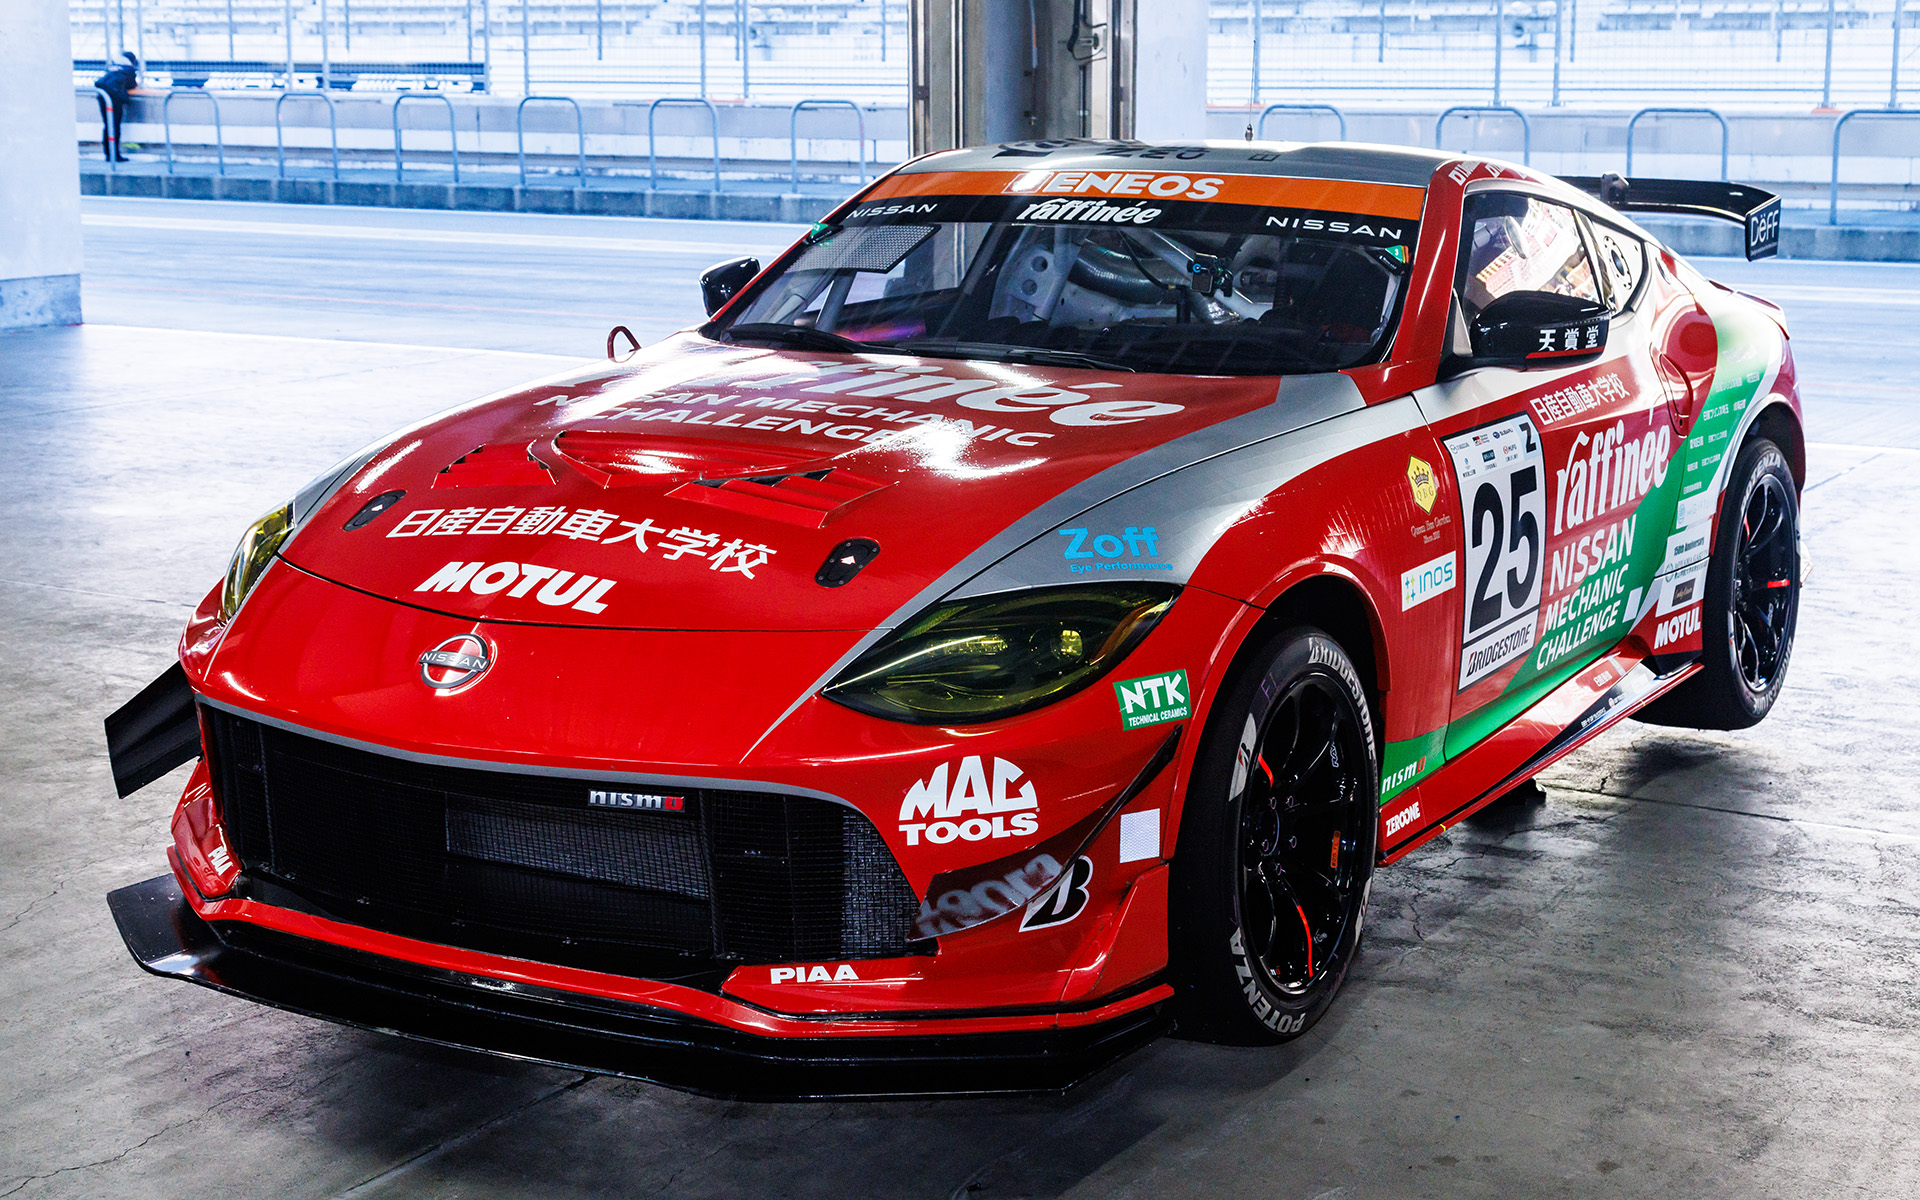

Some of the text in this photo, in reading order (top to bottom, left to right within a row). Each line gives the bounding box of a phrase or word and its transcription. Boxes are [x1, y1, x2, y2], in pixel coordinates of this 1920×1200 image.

[1042, 172, 1224, 199] ENEOS
[846, 203, 937, 219] NISSAN
[1015, 197, 1162, 224] raffinée
[1265, 215, 1402, 240] NISSAN
[533, 391, 741, 406] NSAN
[1529, 372, 1631, 425] 日産自動車大学校
[386, 506, 777, 579] 日産自動車大学校
[1058, 526, 1160, 559] Zoff
[1469, 464, 1540, 635] 25
[1549, 513, 1637, 597] NISSAN
[1070, 561, 1174, 574] Eye Performance
[414, 561, 617, 614] MOTUL
[1542, 563, 1630, 636] MECHANIC
[1536, 600, 1622, 670] CHALLENGE
[1654, 606, 1701, 650] MOTUL
[421, 652, 488, 670] NISSAN
[1466, 623, 1532, 678] BRIDGESTONE
[1120, 673, 1186, 714] NTK
[1128, 706, 1188, 728] TECHNICAL CERAMICS
[899, 755, 1038, 821] MAC
[899, 812, 1039, 846] TOOLS
[208, 845, 234, 877] PIAA
[770, 964, 860, 984] PIAA
[1229, 926, 1307, 1033] POTENZA
